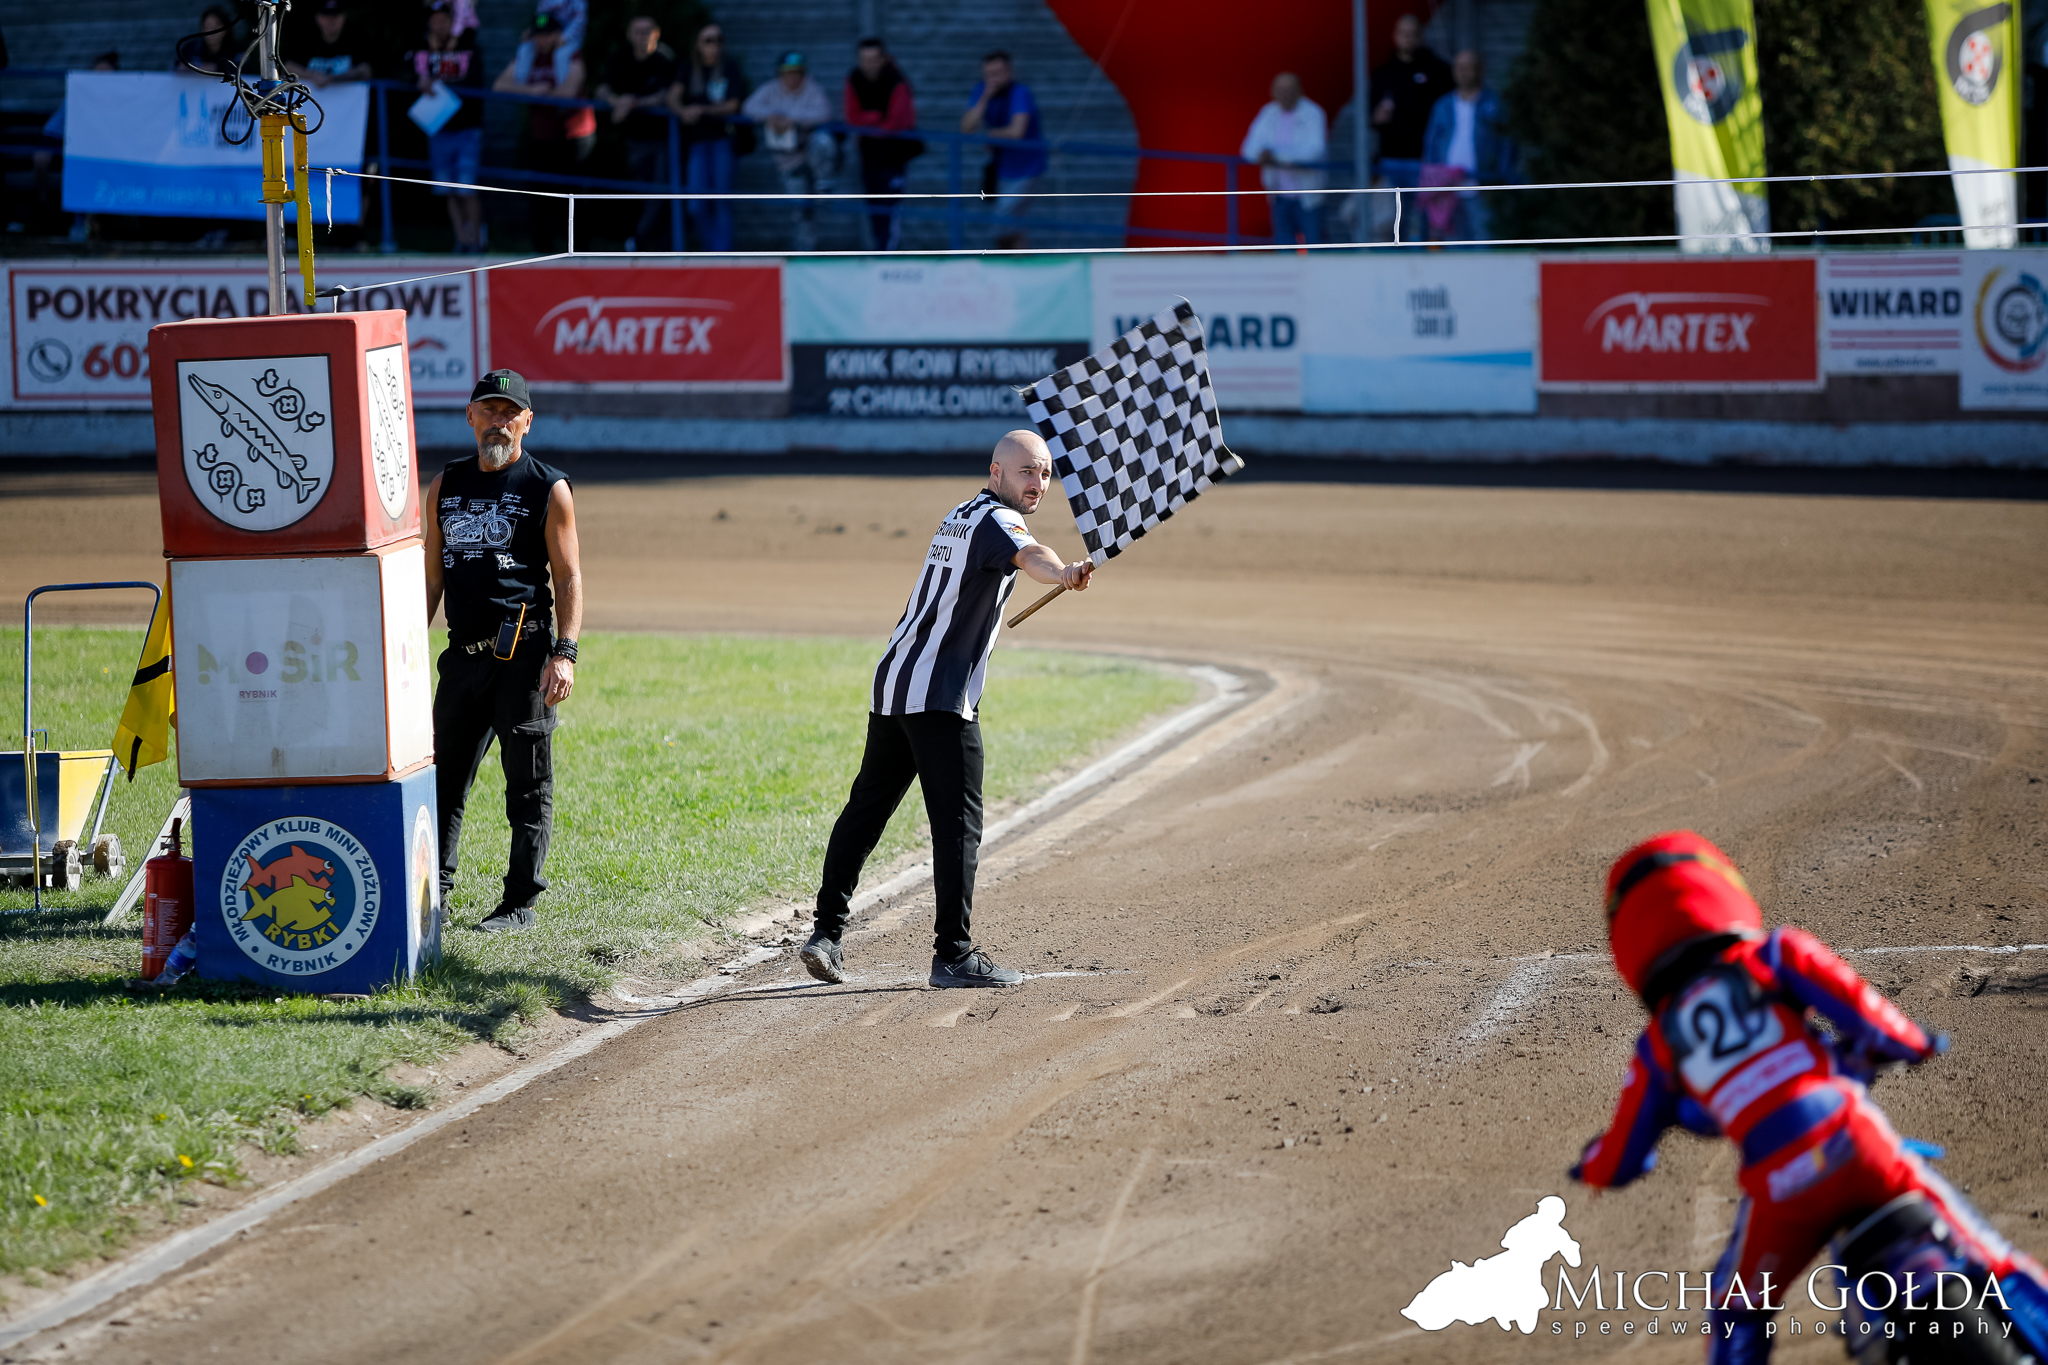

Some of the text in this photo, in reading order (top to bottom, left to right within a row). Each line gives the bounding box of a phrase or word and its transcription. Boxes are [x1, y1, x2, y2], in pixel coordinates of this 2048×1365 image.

[27, 284, 239, 320] POKRYCIA
[1829, 288, 1961, 318] WIKARD
[553, 315, 716, 355] MARTEX
[1602, 312, 1755, 353] MARTEX
[239, 689, 277, 698] RYBNIK
[225, 828, 270, 943] MŁODZIEŻOWY
[275, 820, 321, 835] KLUB
[325, 826, 360, 856] MINI
[354, 855, 379, 939] ŻUŻLOWY
[264, 920, 341, 950] RYBKI
[266, 951, 339, 972] RYBNIK
